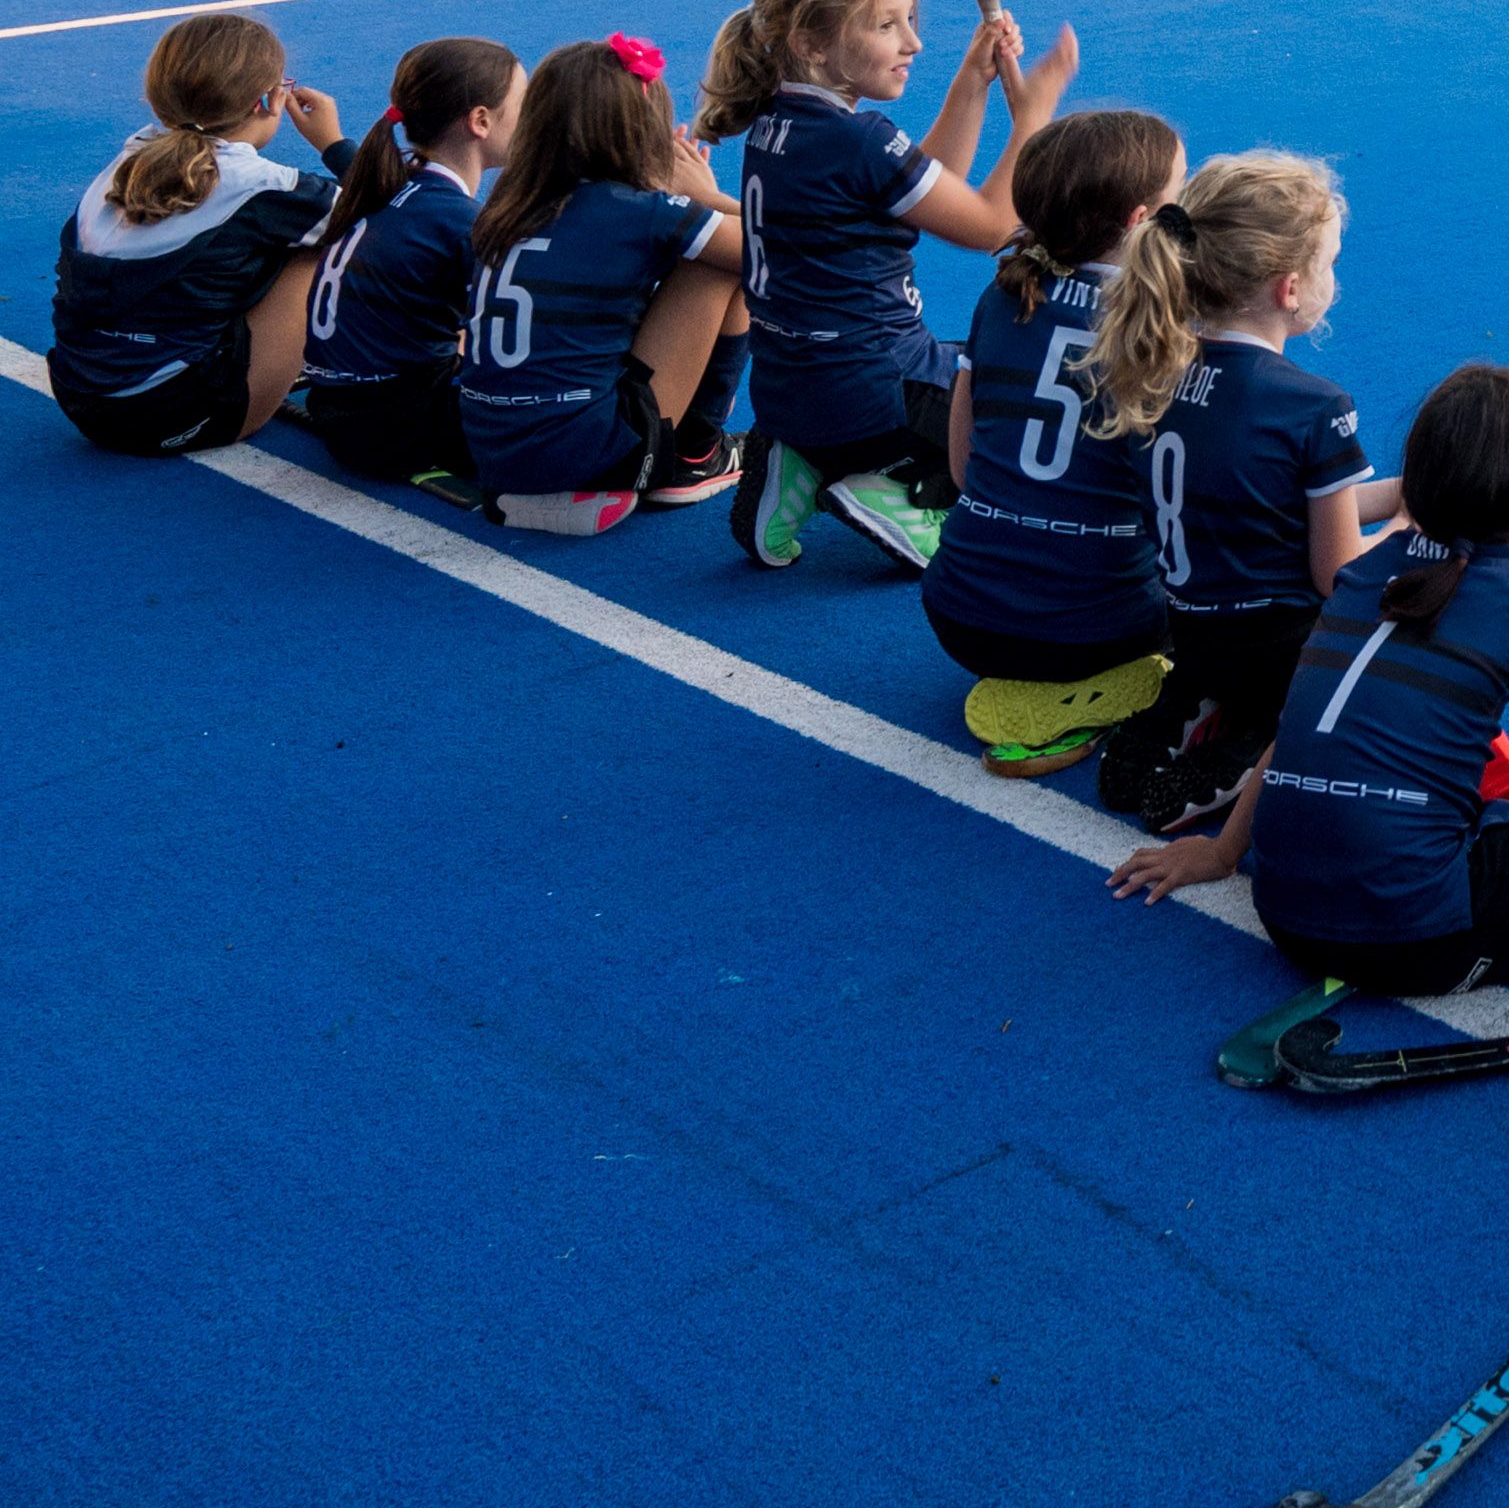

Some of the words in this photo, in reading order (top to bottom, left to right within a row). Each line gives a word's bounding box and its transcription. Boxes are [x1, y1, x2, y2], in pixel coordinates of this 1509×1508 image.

[311, 218, 367, 341] 8
[471, 238, 552, 368] 15
[1020, 326, 1102, 482] 5
[957, 494, 1138, 538] PORSCHE
[1152, 432, 1191, 587] 8
